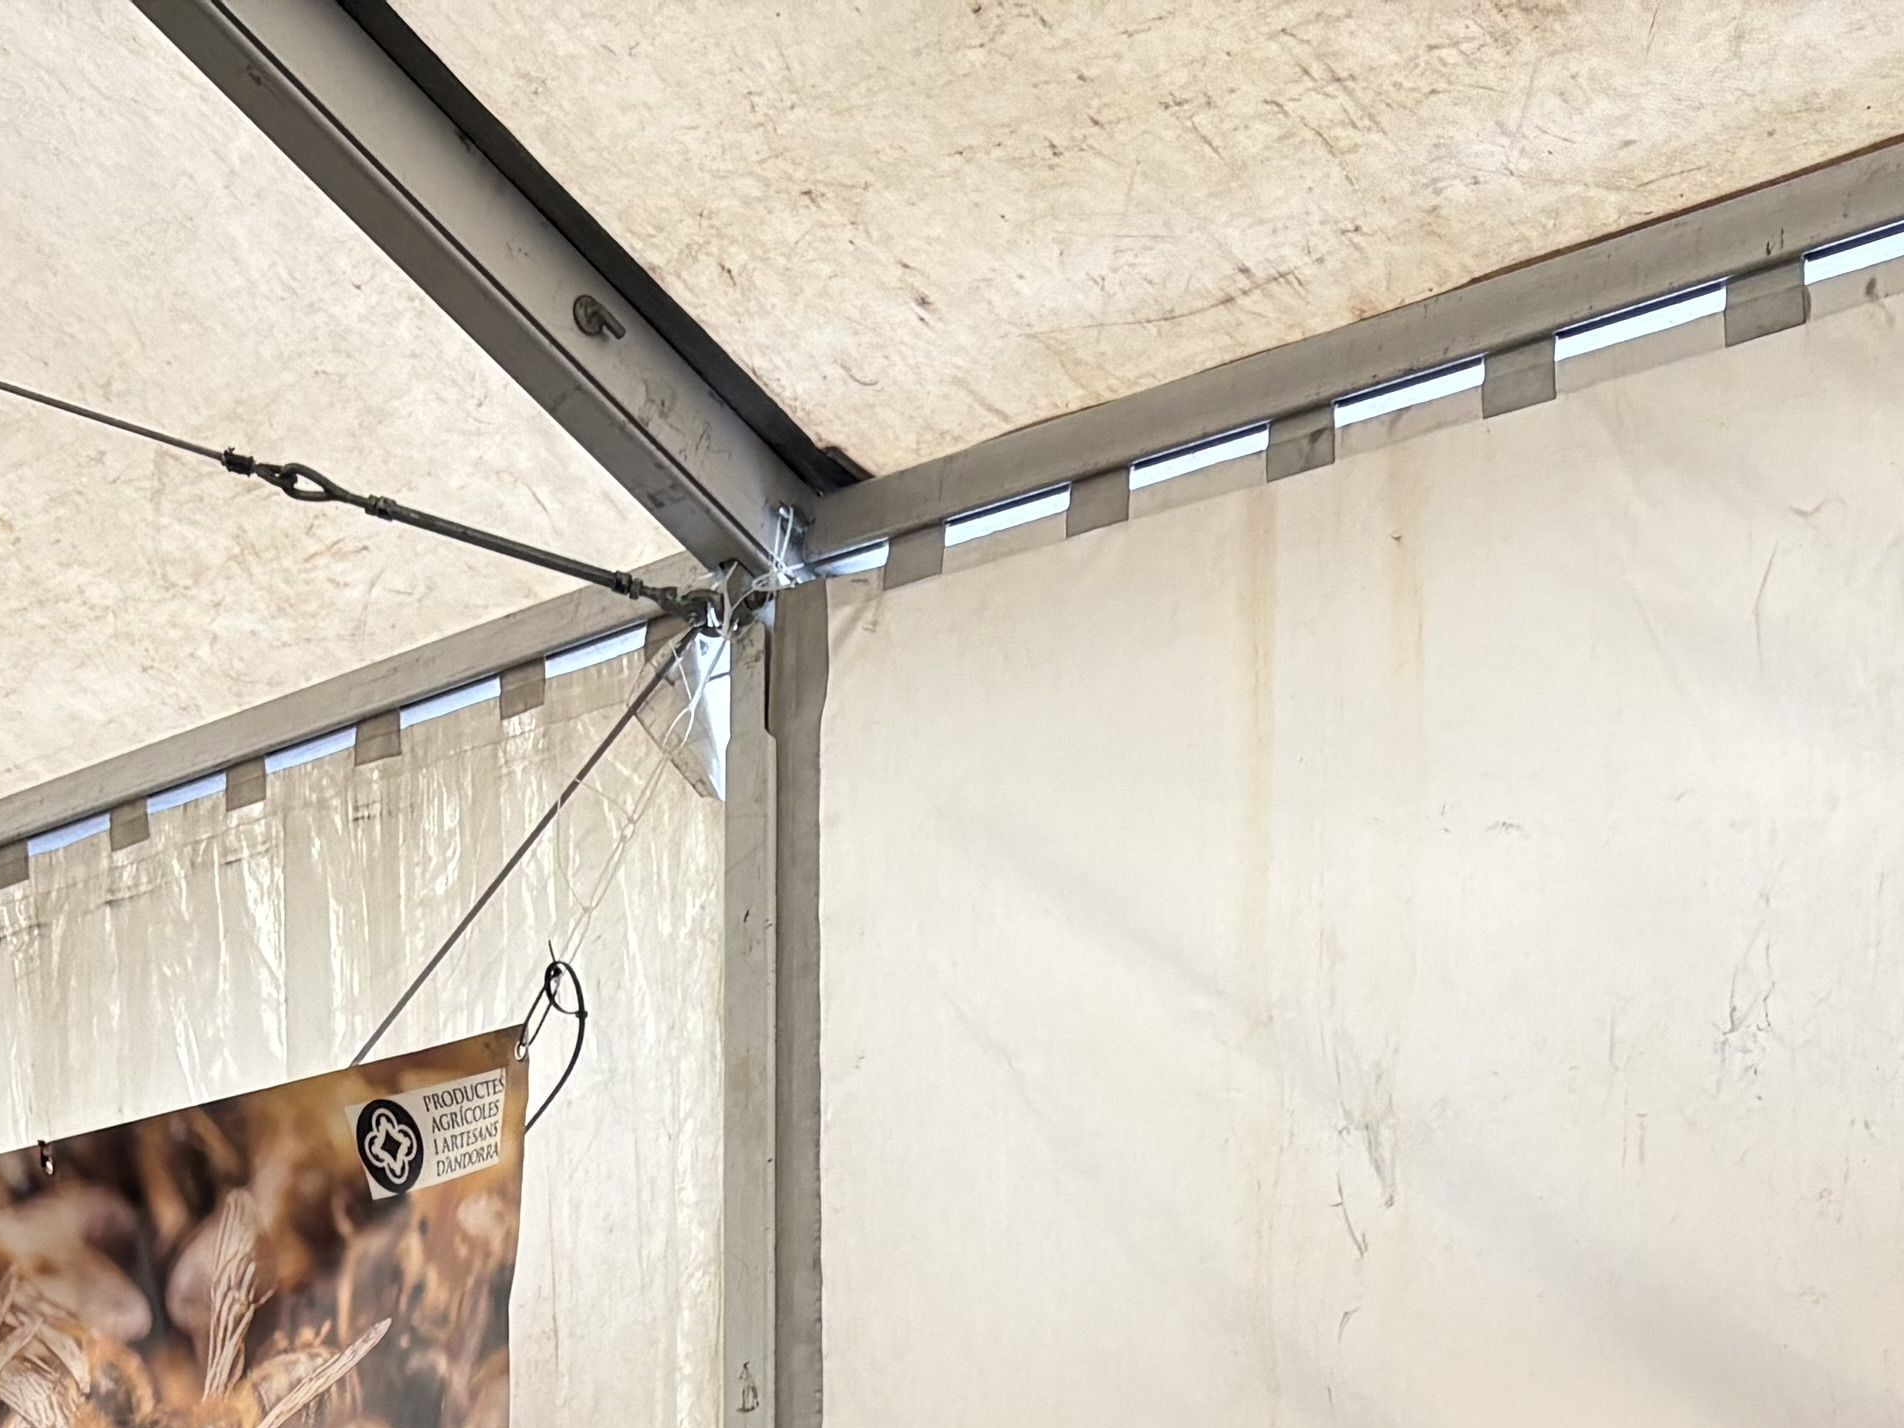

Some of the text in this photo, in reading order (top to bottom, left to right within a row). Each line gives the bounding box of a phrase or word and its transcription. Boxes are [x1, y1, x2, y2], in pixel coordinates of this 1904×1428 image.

[423, 1077, 505, 1112] PRODUCTES
[431, 1099, 500, 1134] AGRÍCOLES
[442, 1120, 499, 1154] ARTESANS
[436, 1143, 499, 1177] D'ANDORRA
